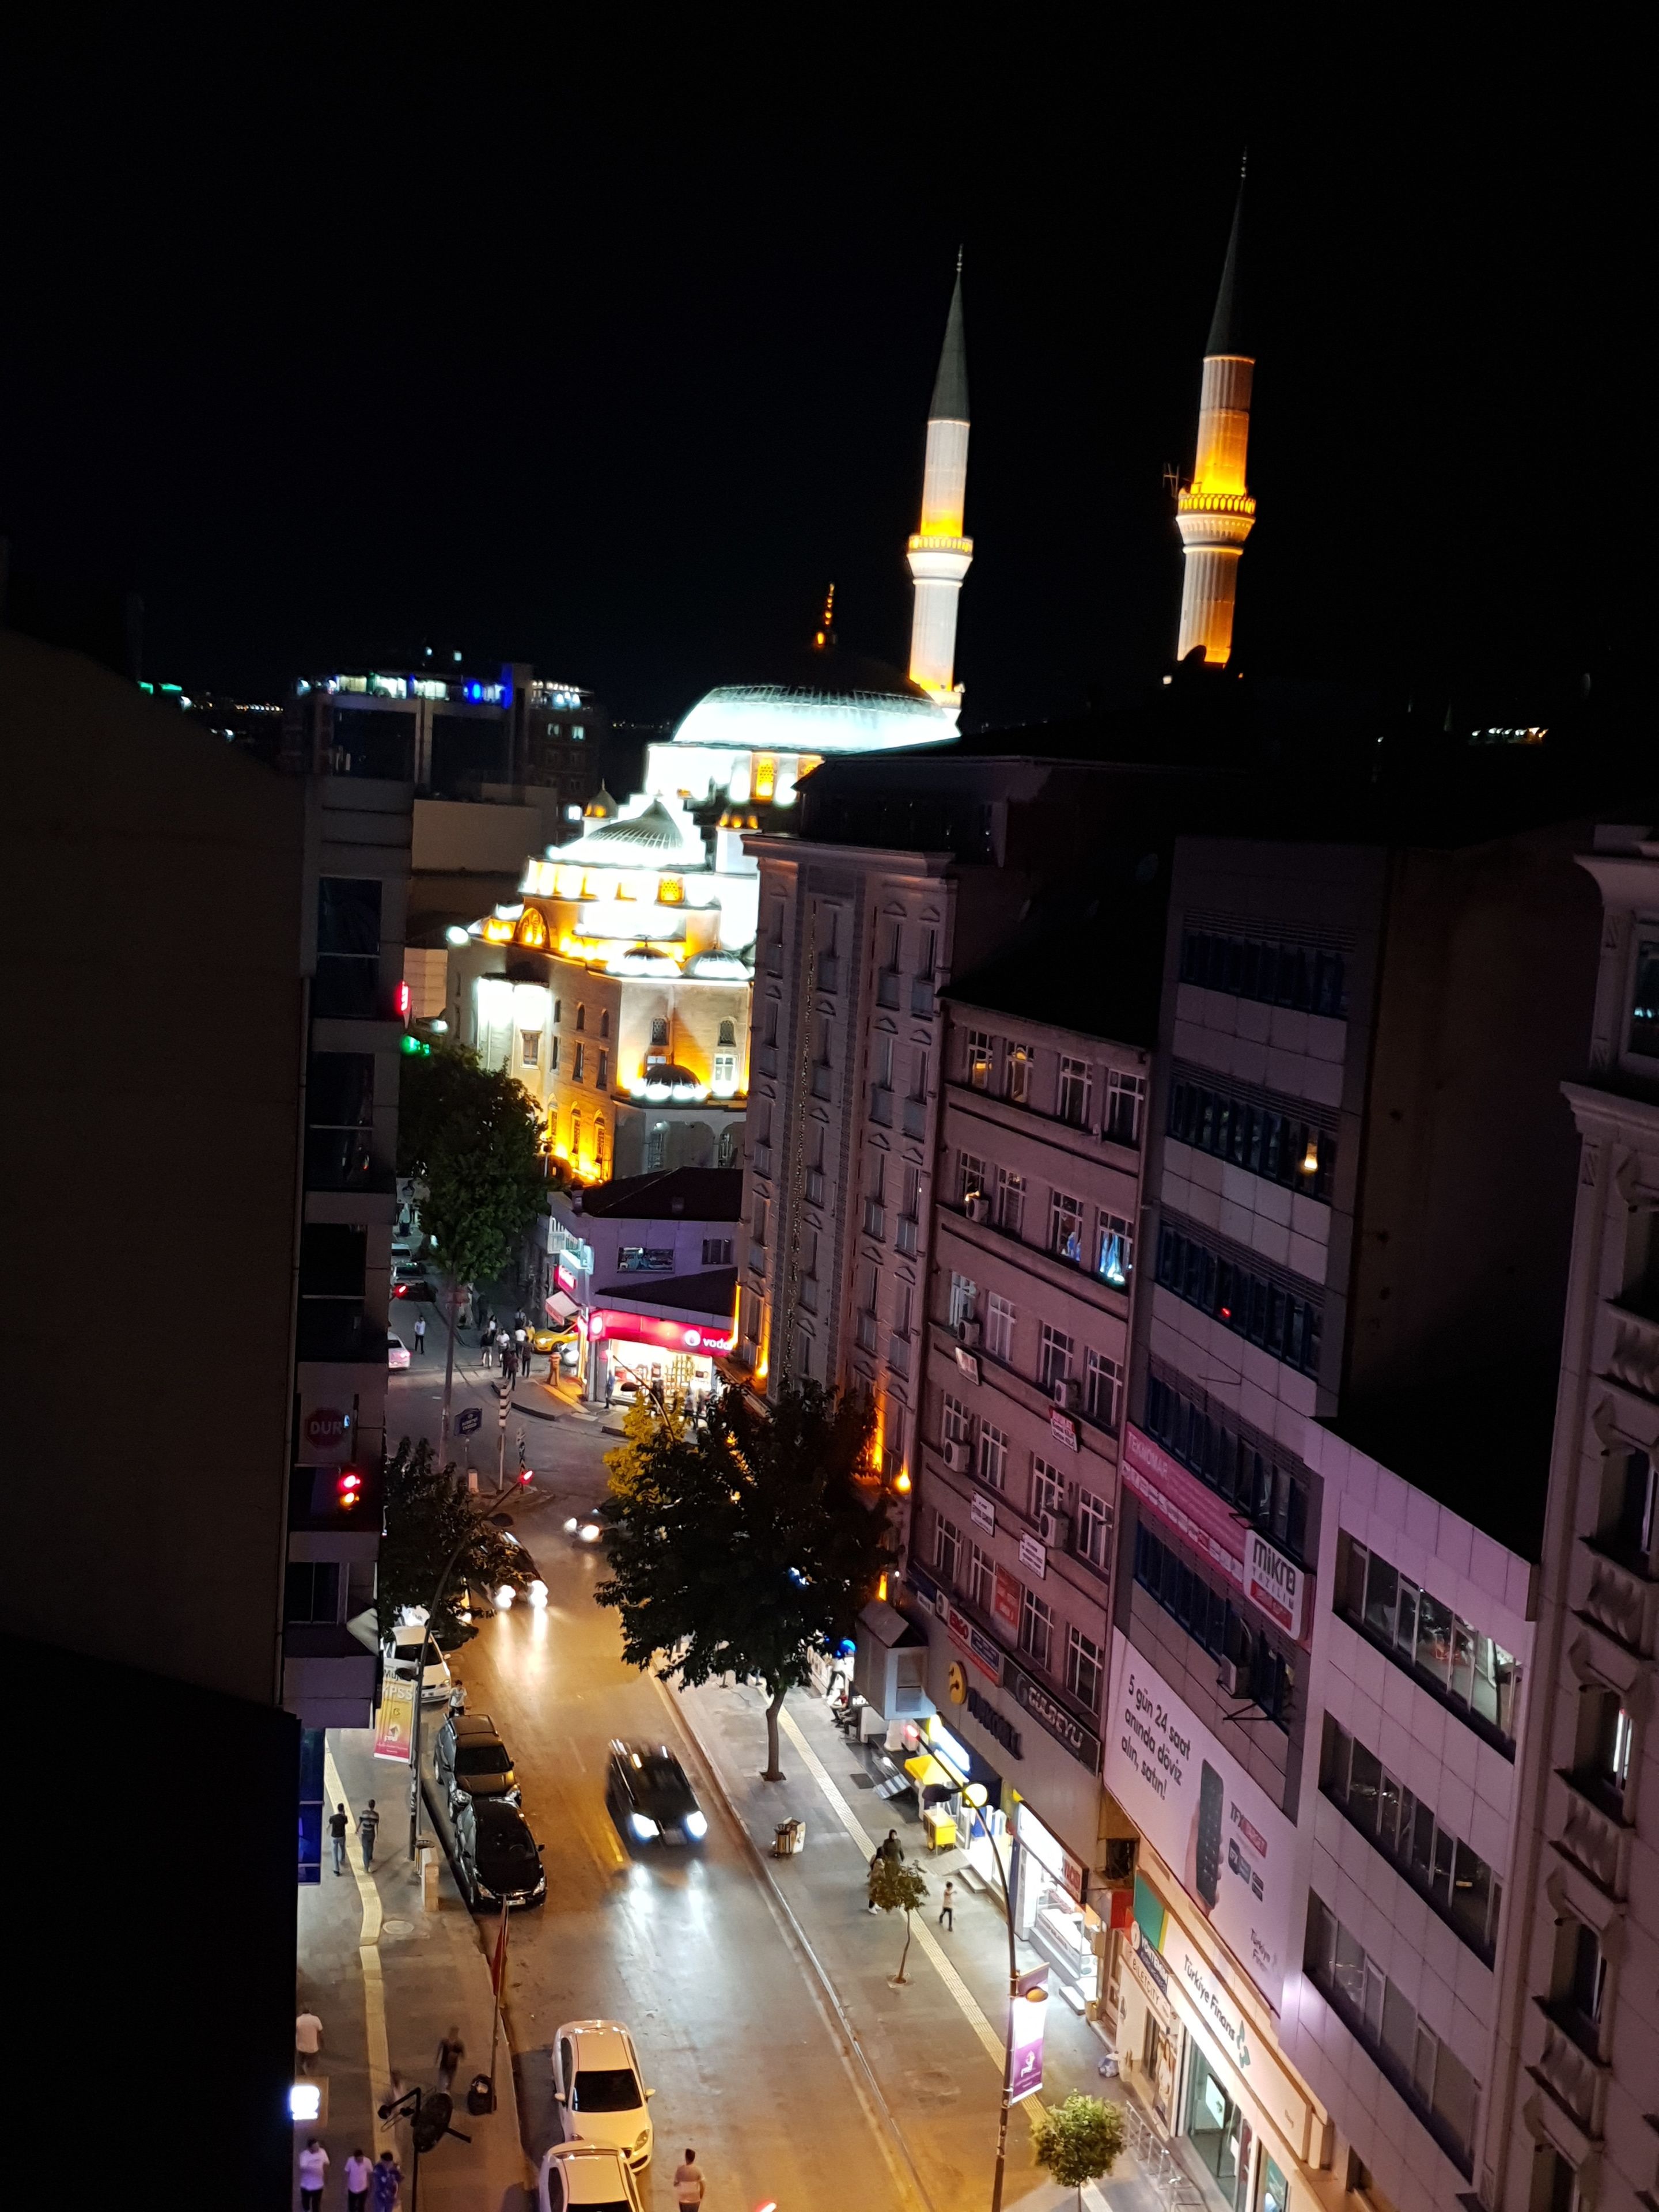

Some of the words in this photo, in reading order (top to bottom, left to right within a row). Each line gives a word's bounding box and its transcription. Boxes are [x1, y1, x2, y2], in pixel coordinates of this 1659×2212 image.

[310, 1421, 342, 1434] DUR
[1252, 1537, 1296, 1596] mikro
[1125, 1708, 1156, 1753] anında
[1157, 1743, 1182, 1786] döviz
[1128, 1673, 1135, 1696] 5
[1136, 1688, 1153, 1718] gün
[1154, 1704, 1168, 1733] 24
[1168, 1726, 1191, 1761] saat
[1122, 1736, 1139, 1771] alın,
[1141, 1760, 1167, 1800] satın!
[1184, 1953, 1210, 2003] Türkiye
[1210, 1994, 1236, 2041] Finans
